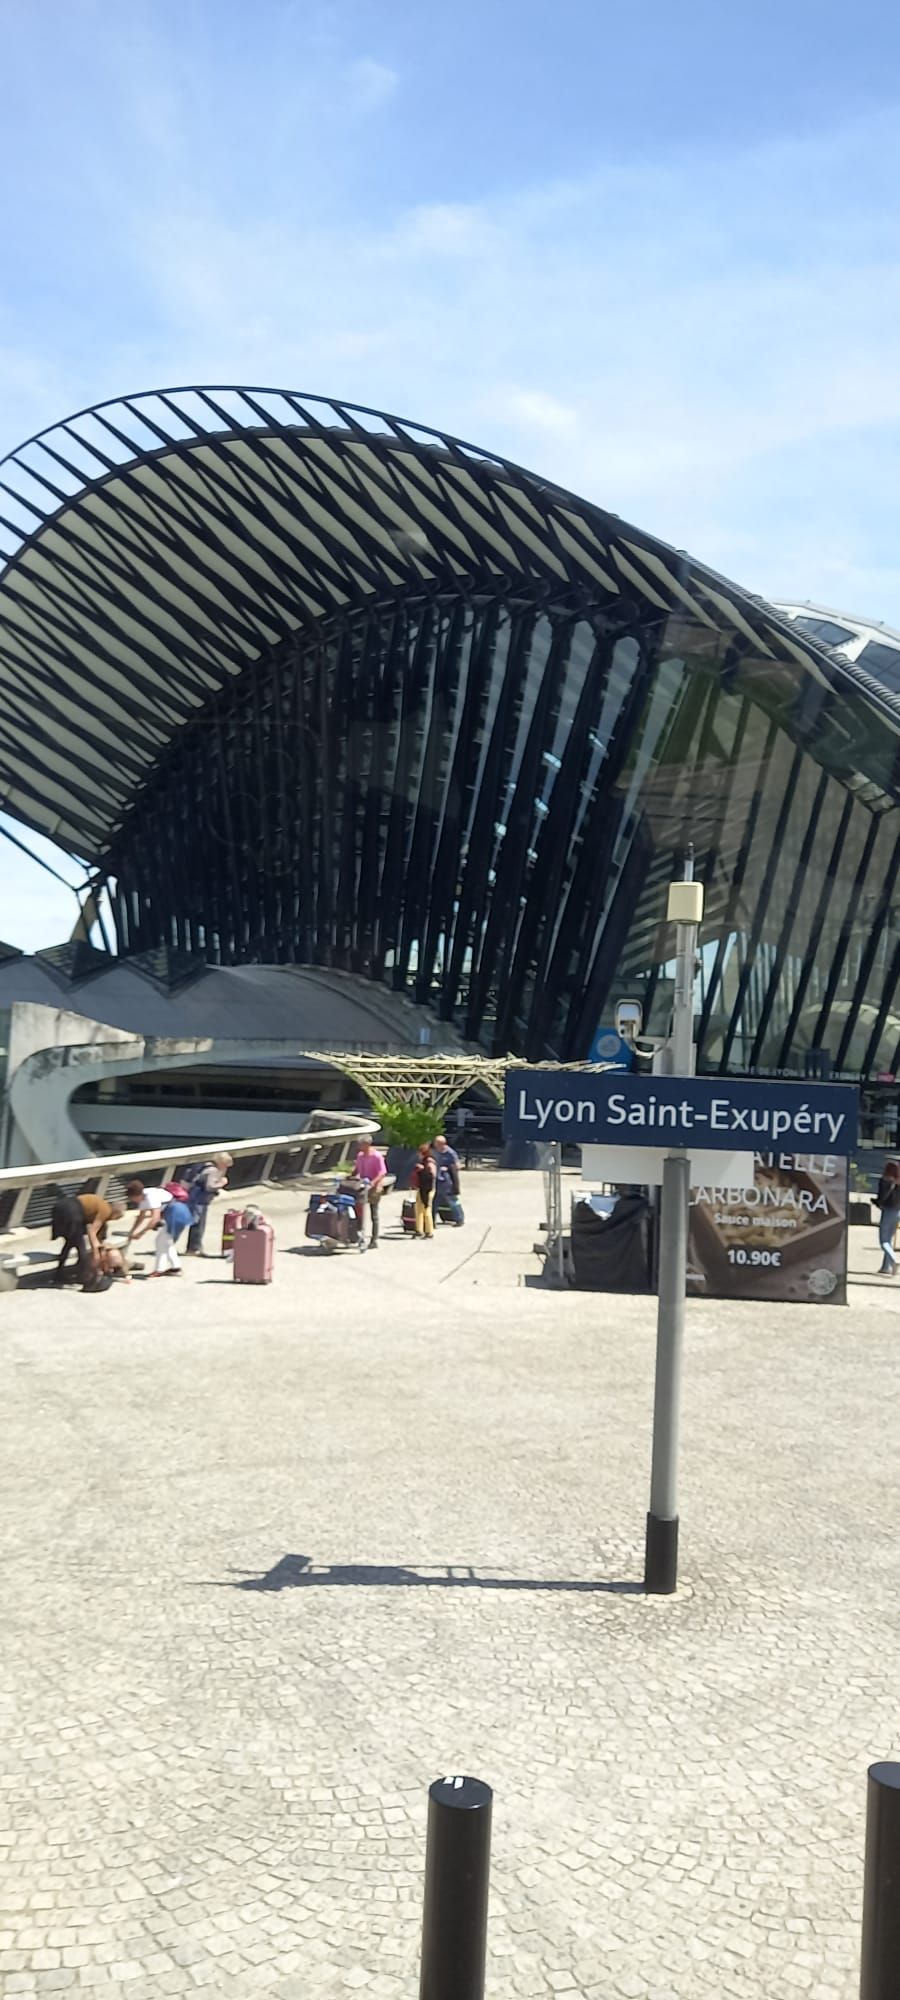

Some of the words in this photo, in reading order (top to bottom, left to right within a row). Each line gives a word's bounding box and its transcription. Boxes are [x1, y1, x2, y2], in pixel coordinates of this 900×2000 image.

[519, 1090, 596, 1128] Lyon
[606, 1094, 845, 1143] Saint-Exupéry
[688, 1186, 829, 1215] ARBONARA
[713, 1212, 750, 1226] Sauce
[752, 1215, 798, 1229] maison
[727, 1249, 783, 1267] 10.90€
